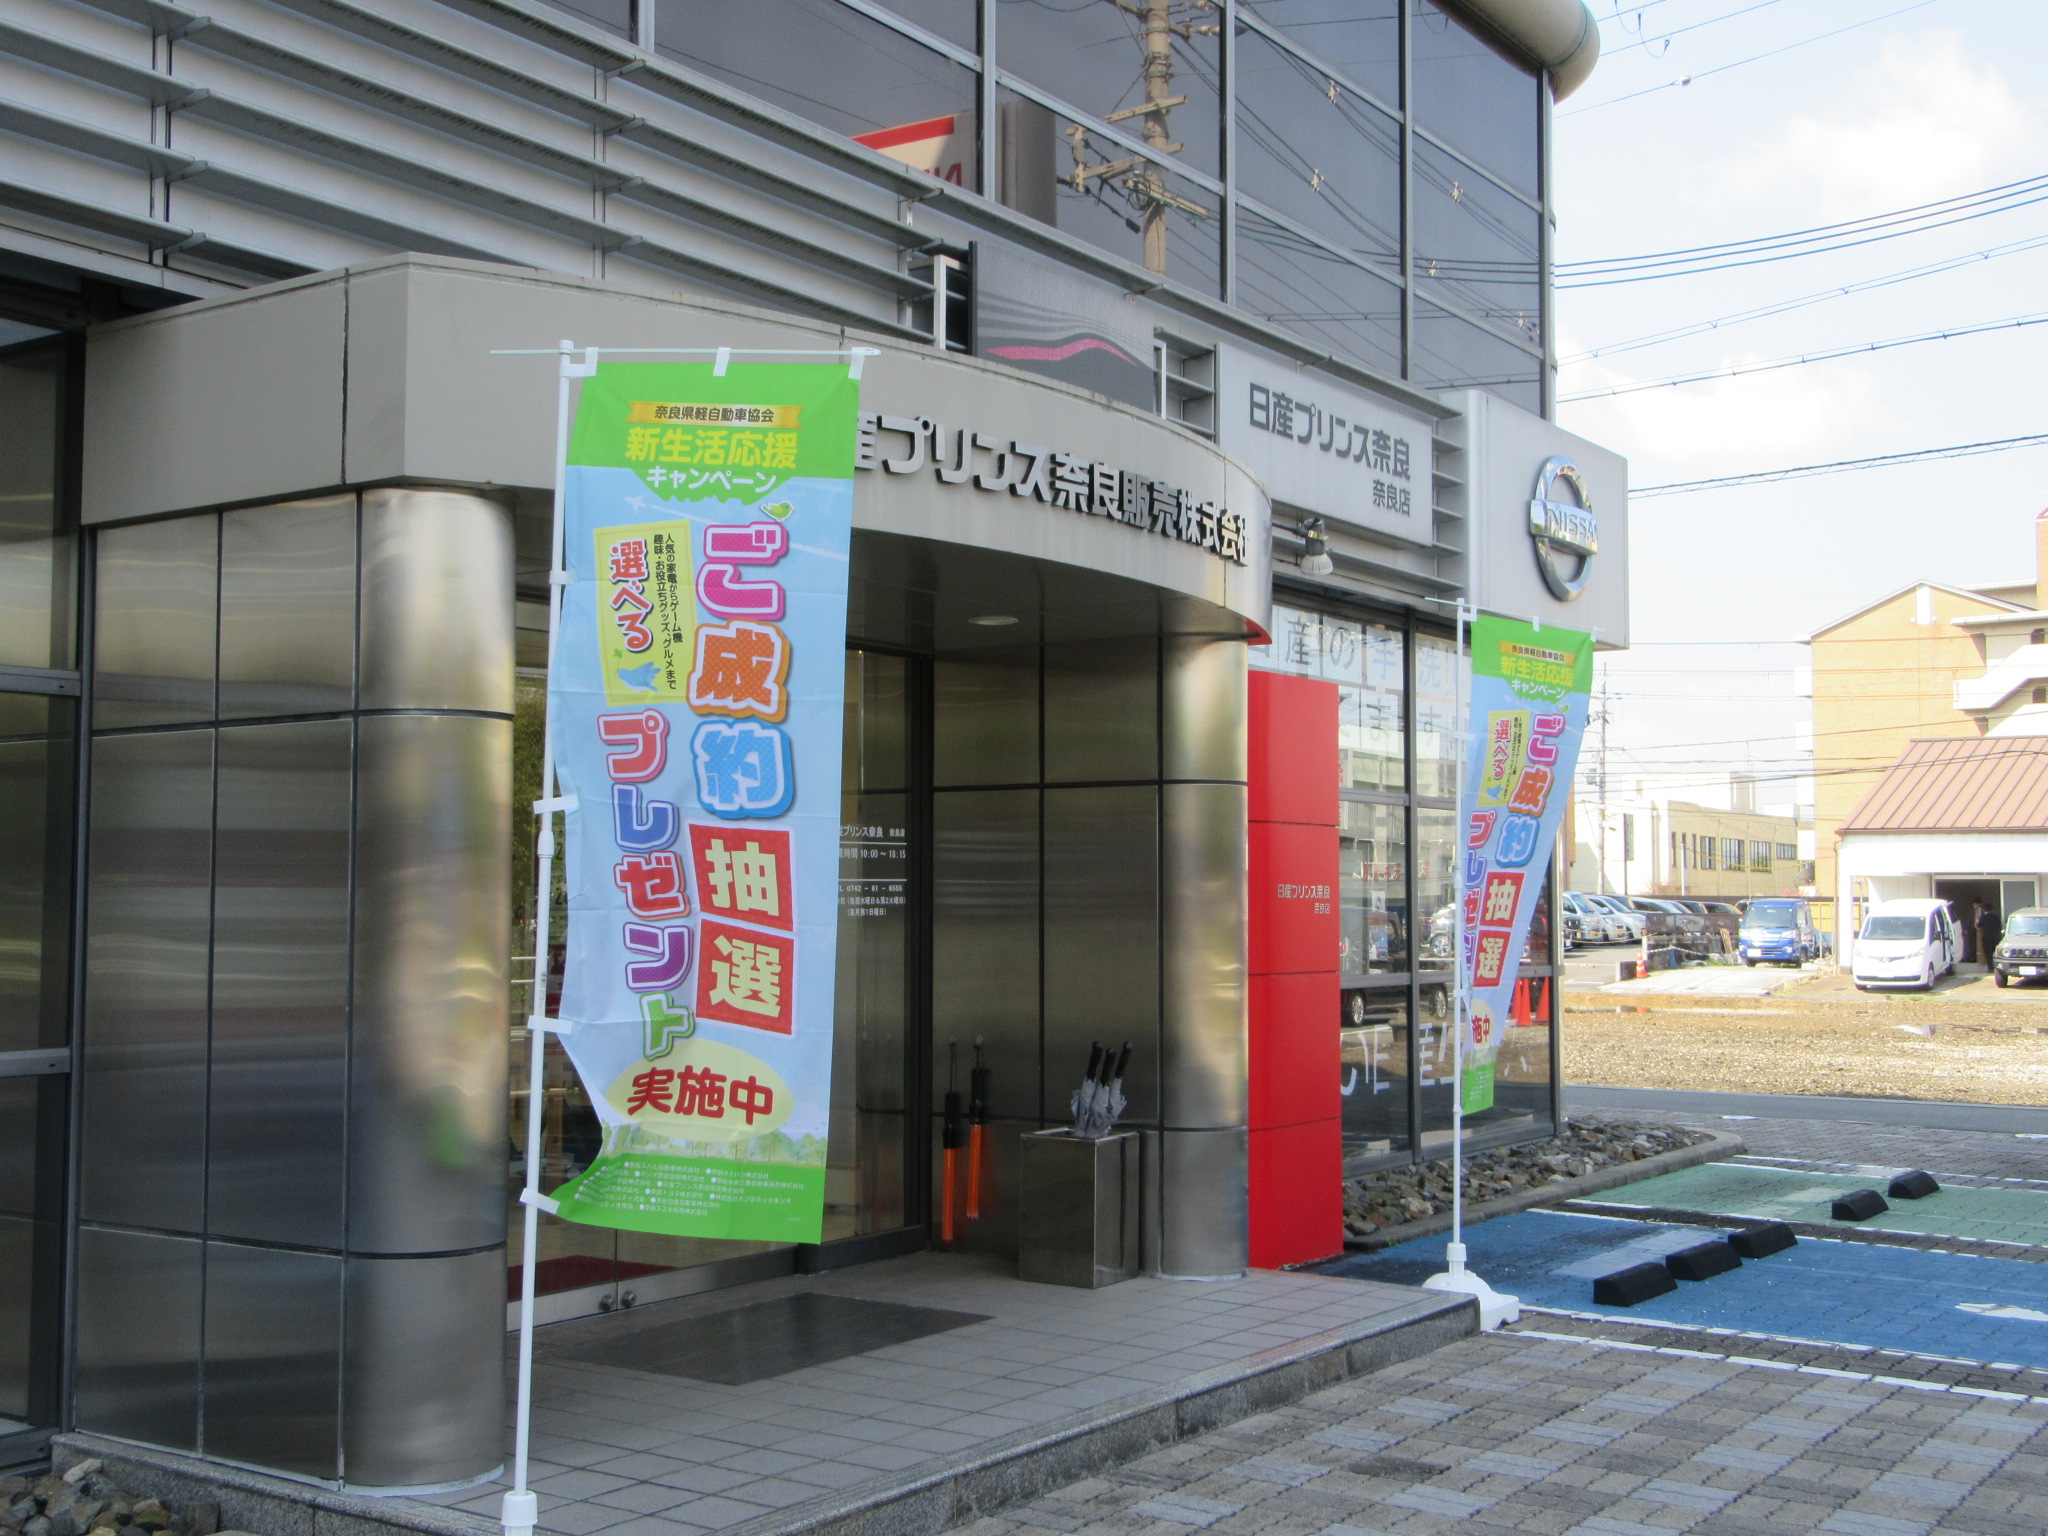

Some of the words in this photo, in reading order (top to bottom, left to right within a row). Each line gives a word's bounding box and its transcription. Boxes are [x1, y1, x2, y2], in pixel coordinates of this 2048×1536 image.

[655, 405, 774, 423] 奈良県軽自動車協会
[1250, 382, 1410, 480] 日産プリンス奈良
[625, 427, 798, 469] 新生活応援
[647, 466, 777, 493] キャンペーン
[1372, 478, 1411, 517] 奈良店
[609, 539, 653, 652] 選べる
[665, 533, 684, 643] 人気の家電からゲーム機
[1500, 656, 1574, 687] 新生活応援
[1512, 679, 1566, 698] キャンペーン
[1493, 719, 1511, 780] 選べる
[860, 849, 878, 858] 10:00
[889, 850, 906, 858] 18:15
[597, 708, 694, 1060] プレゼント
[1278, 884, 1330, 899] 日産プリンス奈良
[627, 1065, 774, 1125] 実施中
